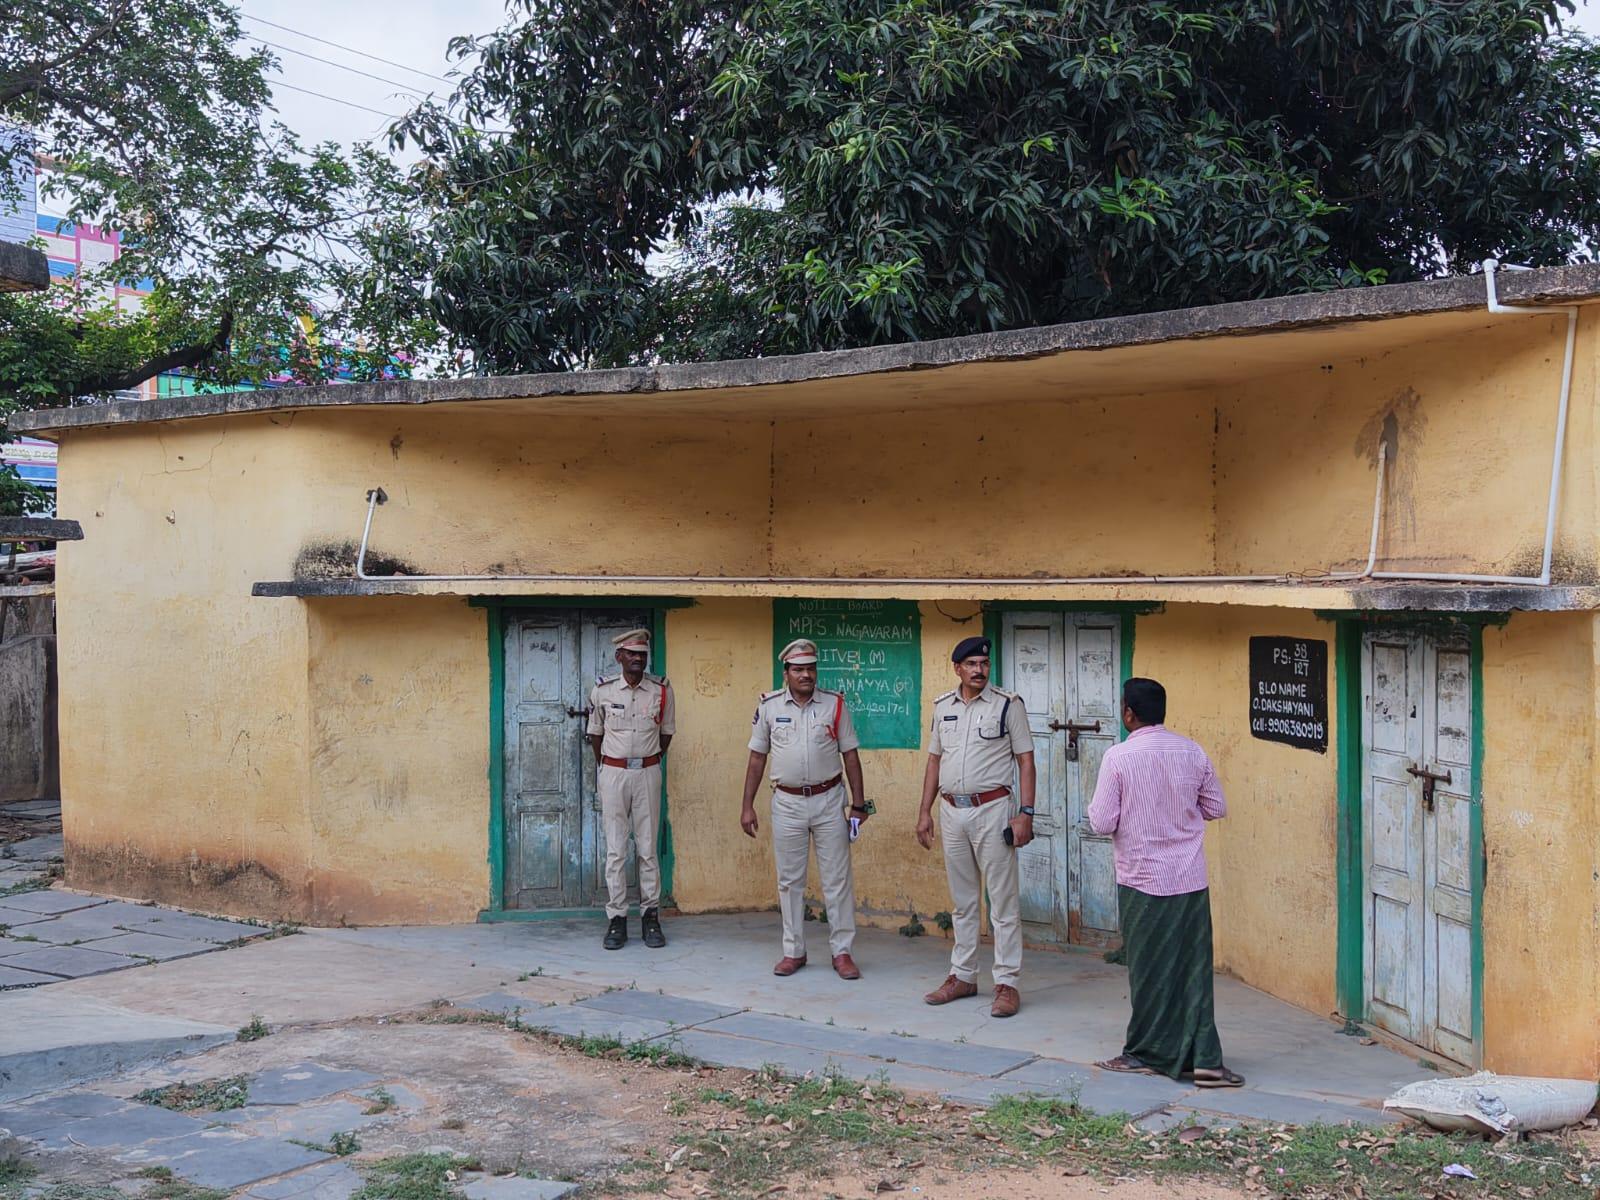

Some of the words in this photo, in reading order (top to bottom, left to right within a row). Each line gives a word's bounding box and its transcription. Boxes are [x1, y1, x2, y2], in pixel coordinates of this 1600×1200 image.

[836, 622, 913, 640] NAGAVARAM
[1294, 643, 1308, 658] 38
[1258, 681, 1277, 695] BLO
[1278, 682, 1307, 698] NAME
